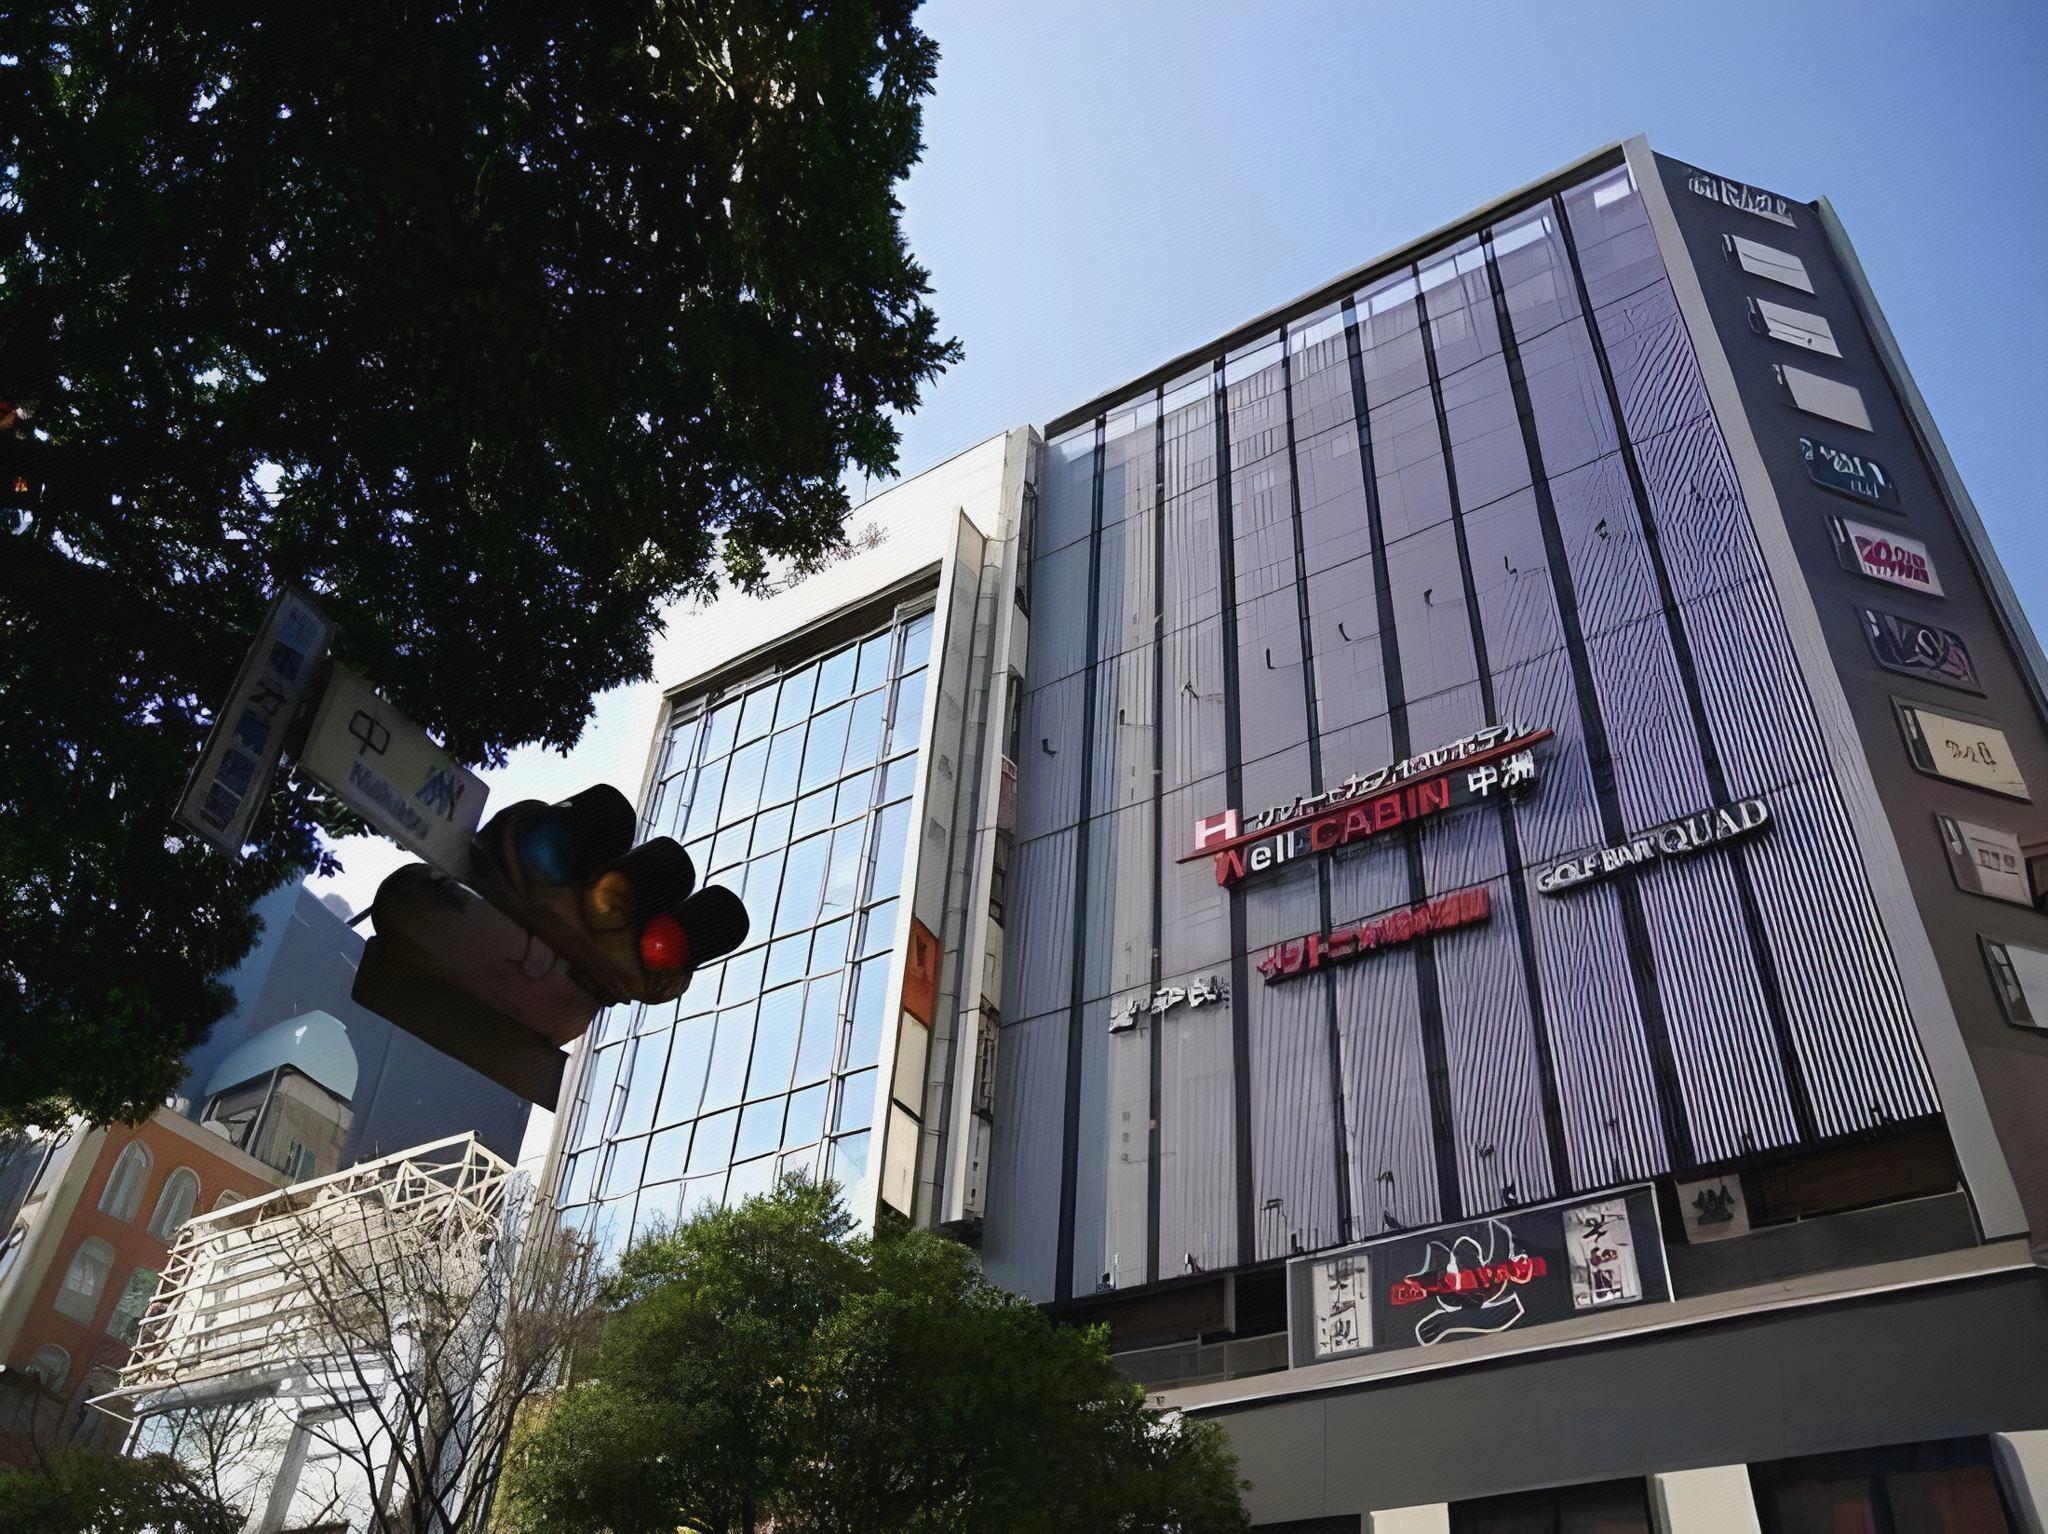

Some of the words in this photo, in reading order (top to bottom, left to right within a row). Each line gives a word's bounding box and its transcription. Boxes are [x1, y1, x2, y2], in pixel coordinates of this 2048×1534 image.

[1310, 776, 1450, 852] CABIN
[1467, 748, 1536, 797] 中洲
[1658, 797, 1769, 853] QUAD
